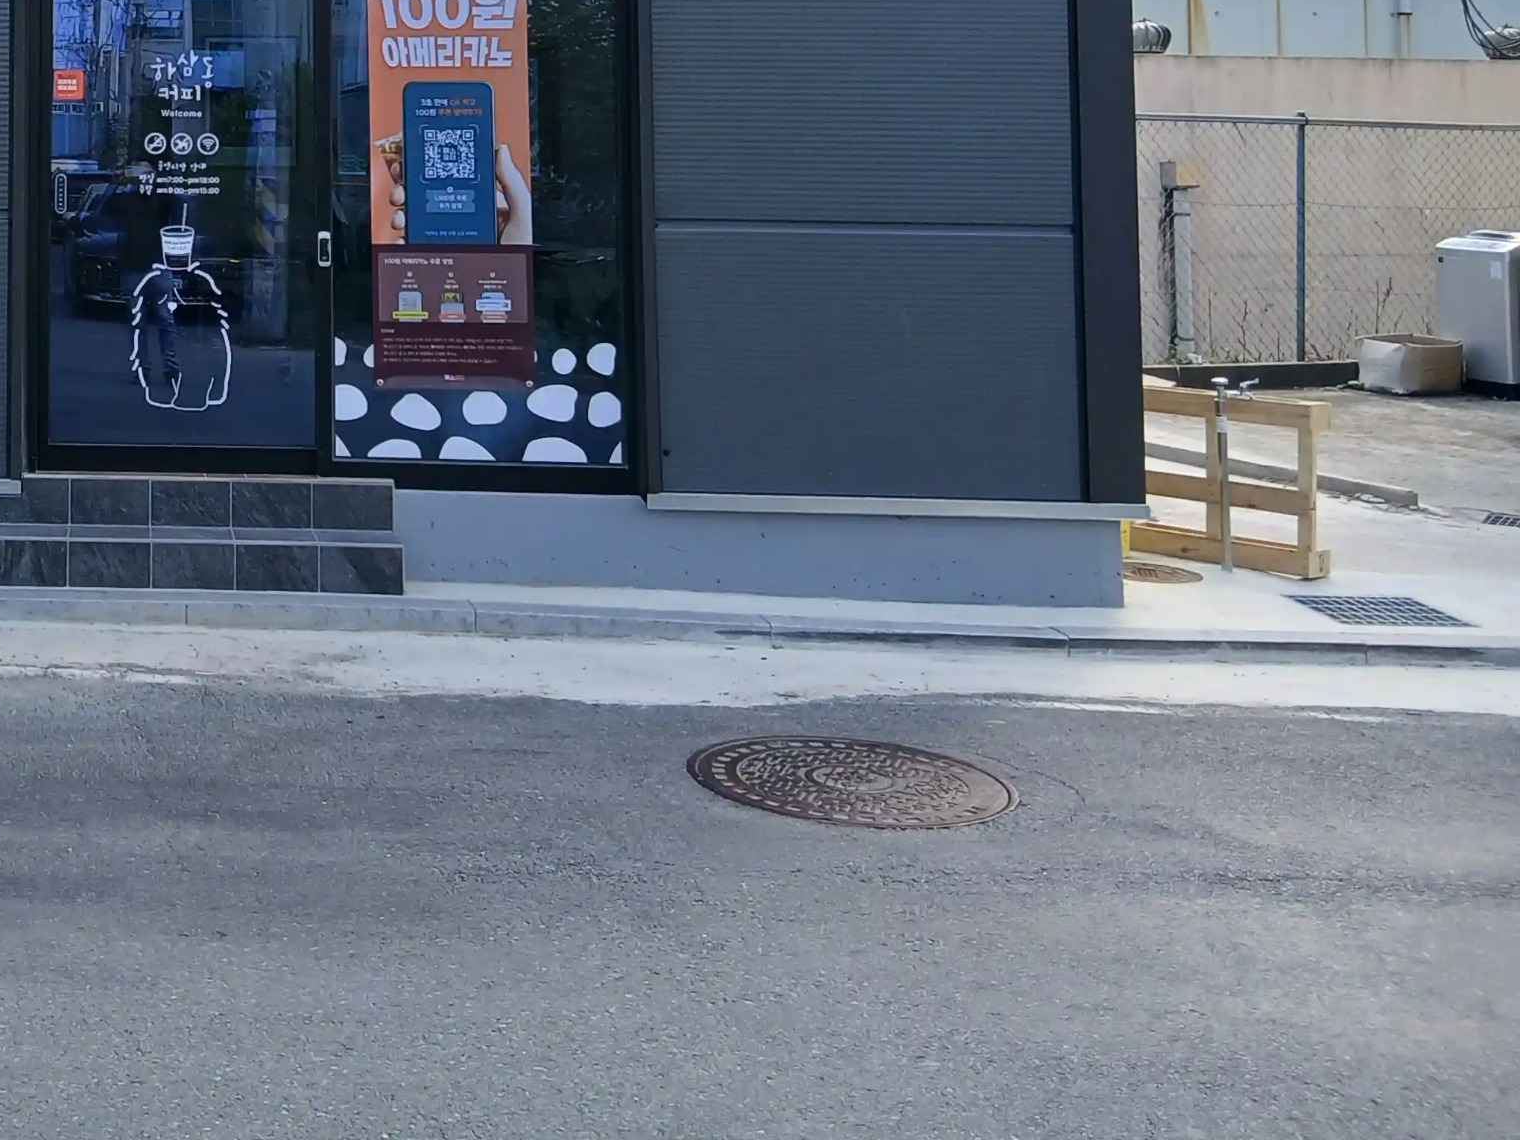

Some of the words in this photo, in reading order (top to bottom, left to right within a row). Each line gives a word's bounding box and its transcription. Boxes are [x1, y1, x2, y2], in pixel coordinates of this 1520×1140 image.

[382, 36, 513, 68] 아메리카노
[150, 48, 215, 89] 하삼동
[157, 84, 202, 102] 커피
[160, 109, 203, 118] Welcome
